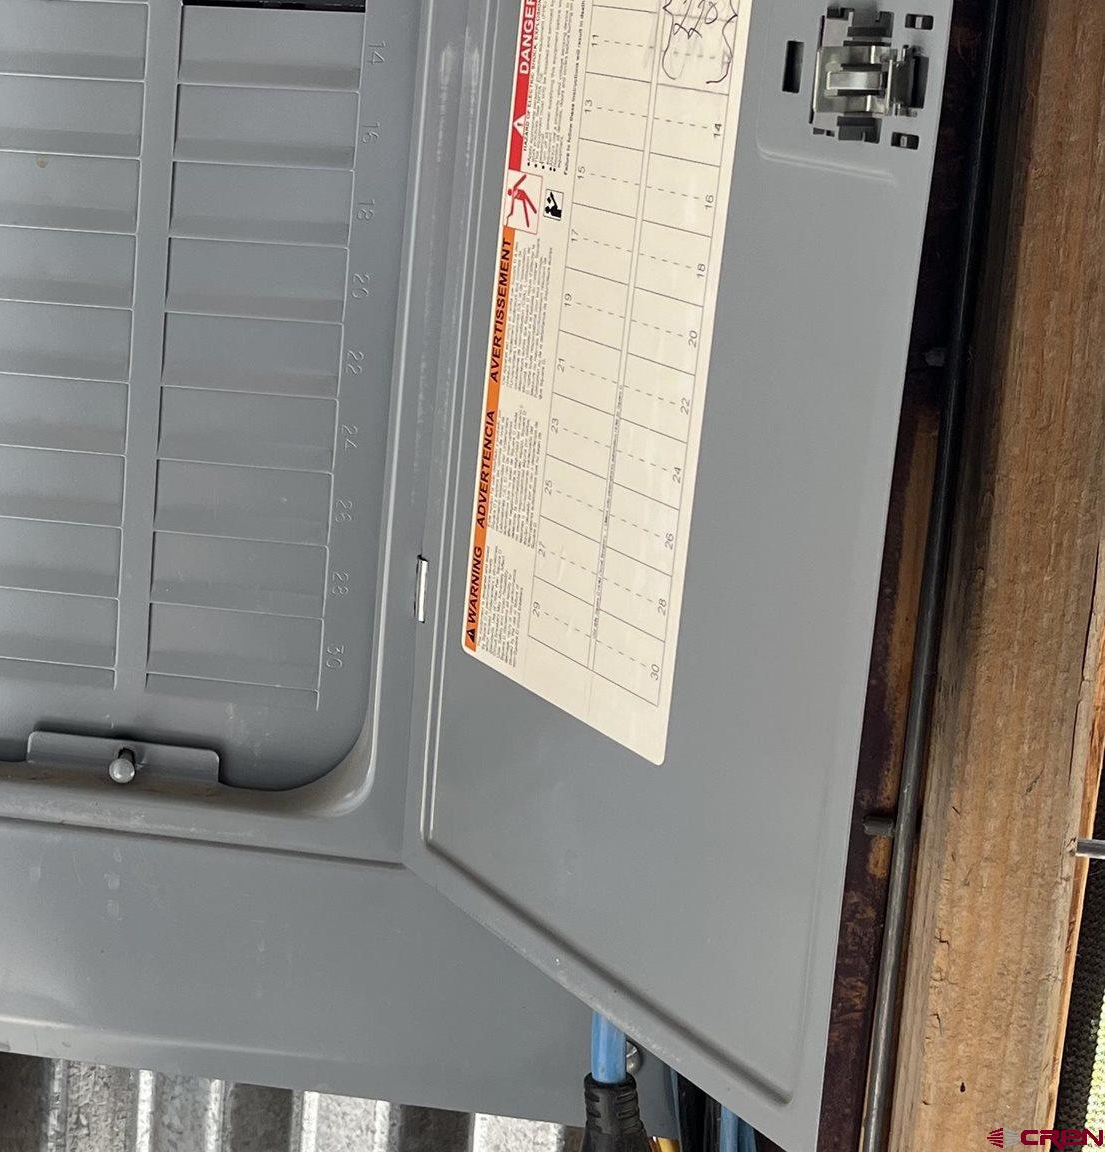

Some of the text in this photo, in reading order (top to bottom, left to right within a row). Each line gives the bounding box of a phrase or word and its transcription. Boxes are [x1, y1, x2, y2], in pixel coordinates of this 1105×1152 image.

[592, 34, 599, 46] 11
[369, 42, 386, 65] 14
[585, 99, 592, 112] 13
[363, 123, 380, 143] 16
[713, 123, 722, 138] 14
[578, 166, 585, 180] 15
[705, 194, 713, 209] 16
[358, 200, 375, 221] 18
[571, 229, 579, 242] 17
[697, 263, 706, 278] 18
[351, 274, 370, 299] 20
[565, 294, 572, 307] 19
[489, 238, 511, 383] AVERTISSEMENT
[688, 331, 698, 348] 20
[347, 351, 364, 374] 22
[557, 357, 565, 371] 21
[680, 398, 690, 415] 22
[551, 418, 559, 434] 23
[342, 425, 358, 450] 24
[476, 408, 495, 528] ADVERTENCIA
[673, 467, 681, 484] 24
[544, 480, 552, 494] 25
[336, 500, 353, 523] 26
[539, 543, 546, 556] 27
[664, 533, 673, 551] 26
[333, 573, 349, 598] 28
[467, 544, 482, 625] WARNING
[532, 602, 540, 617] 29
[658, 599, 667, 616] 28
[327, 645, 343, 668] 30
[650, 664, 659, 680] 30
